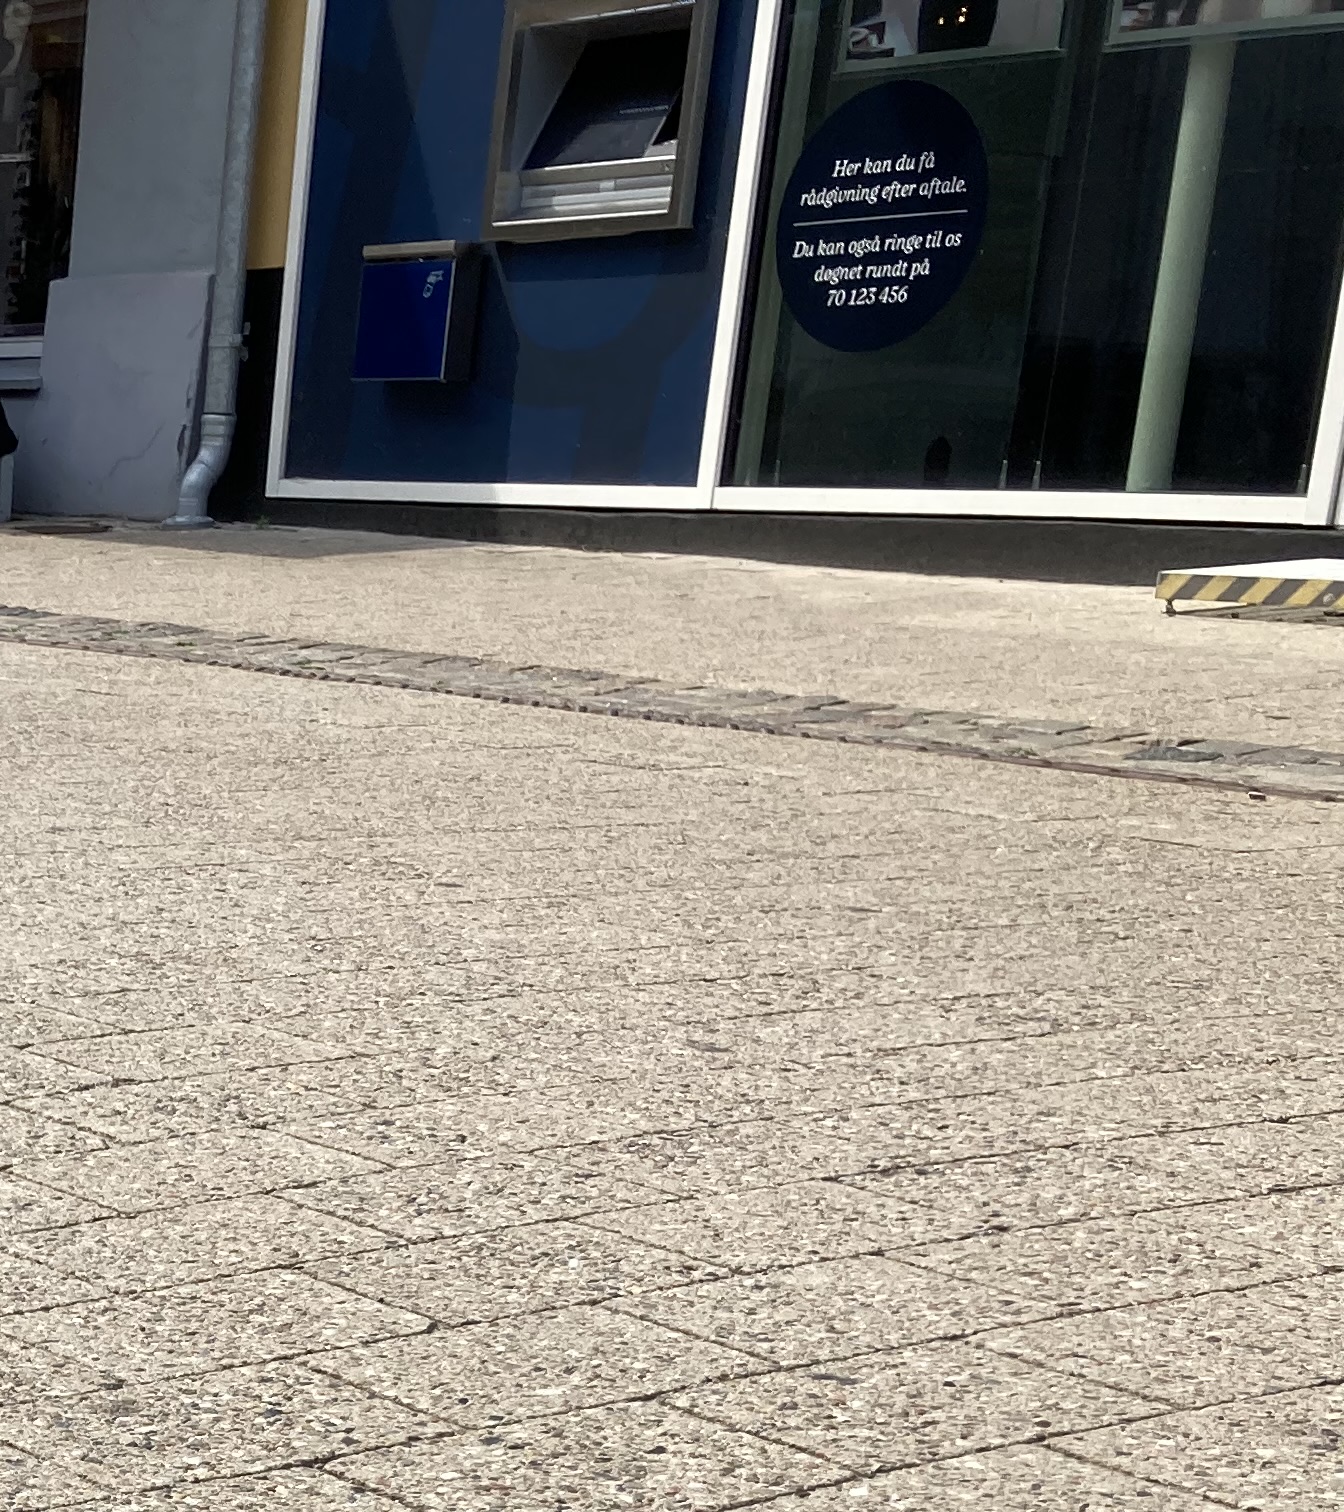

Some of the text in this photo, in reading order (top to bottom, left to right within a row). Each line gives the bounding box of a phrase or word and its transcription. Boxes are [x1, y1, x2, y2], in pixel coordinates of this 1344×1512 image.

[831, 151, 936, 178] Her kan du få
[800, 175, 967, 209] rådgivning efter aftale.
[792, 230, 963, 258] Du kan også ringe til os
[814, 257, 930, 285] døgnet rundt på
[826, 285, 910, 307] 70 123 456
